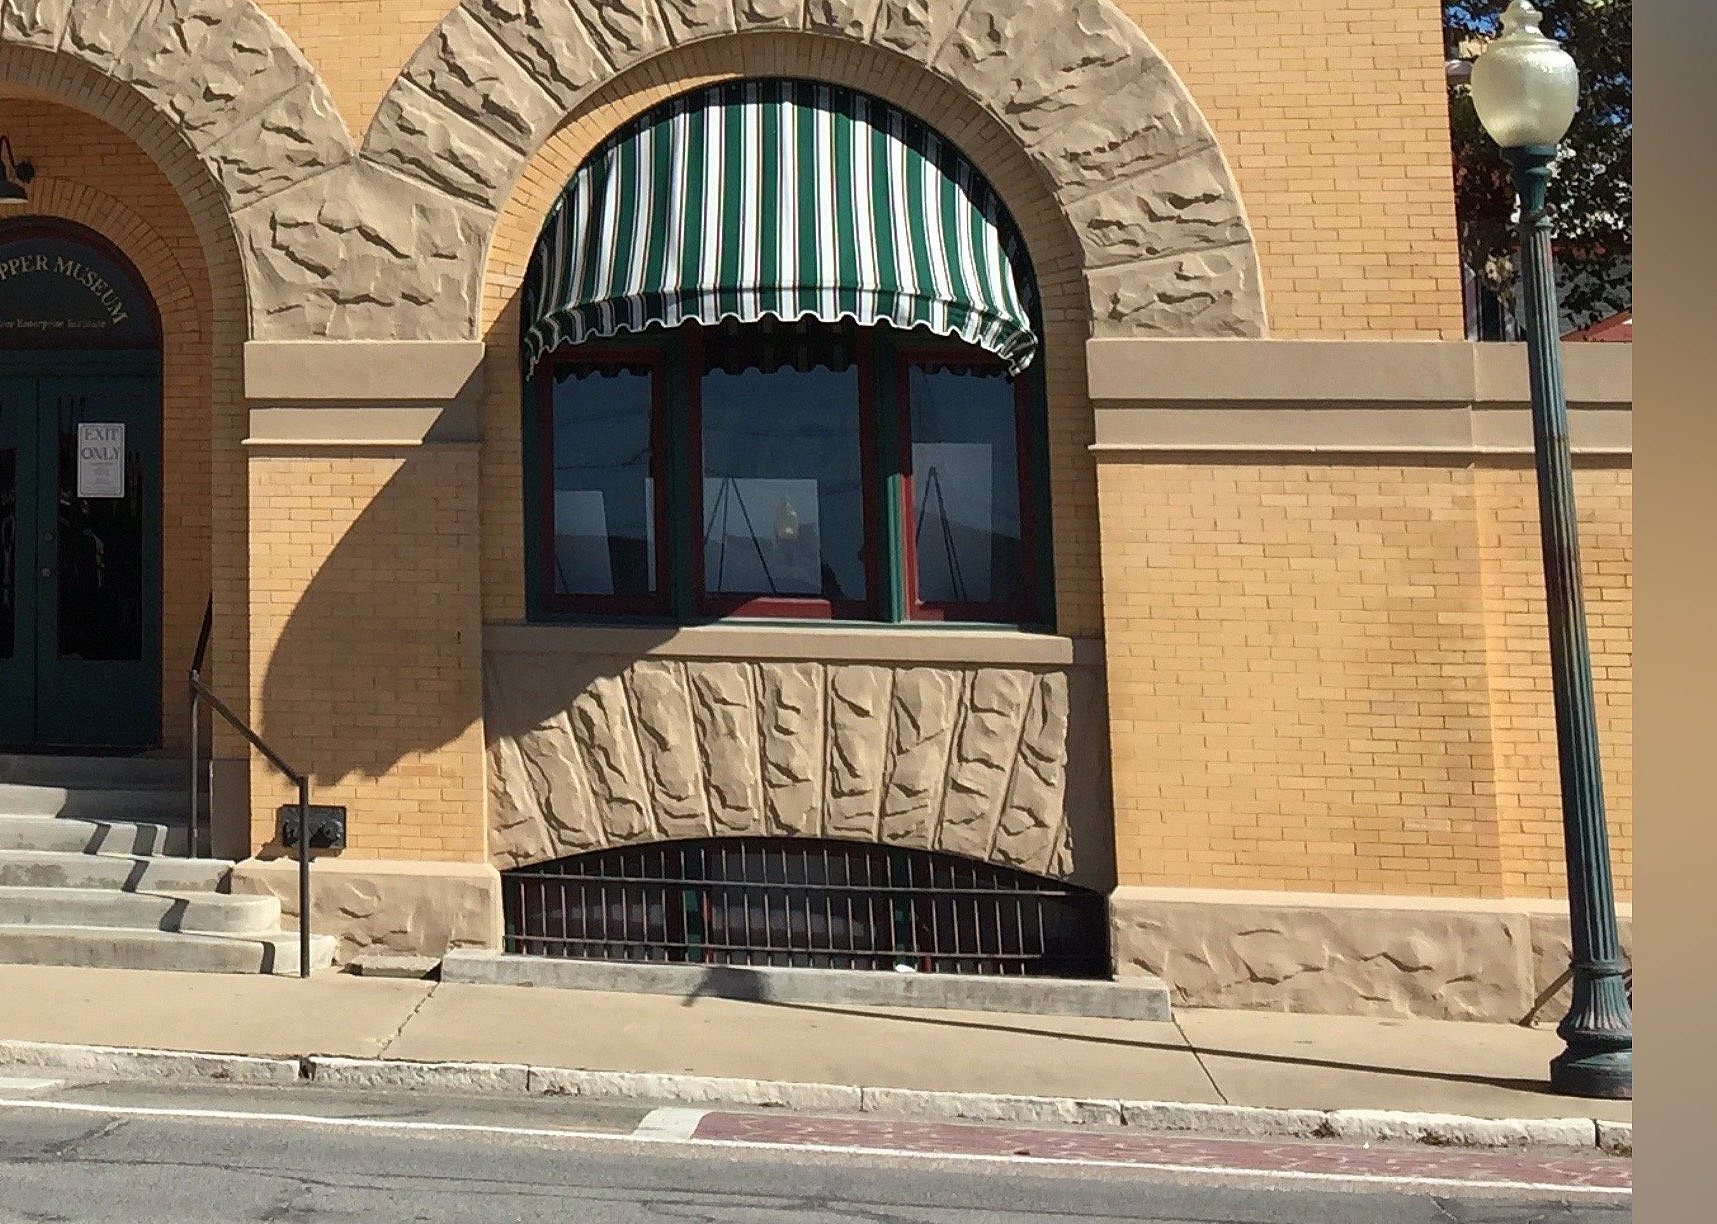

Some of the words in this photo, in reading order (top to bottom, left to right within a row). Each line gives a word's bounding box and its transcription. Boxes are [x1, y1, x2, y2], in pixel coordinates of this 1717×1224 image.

[54, 256, 129, 325] MUSEUM
[85, 428, 117, 441] EXIT
[81, 446, 120, 461] ONLY
